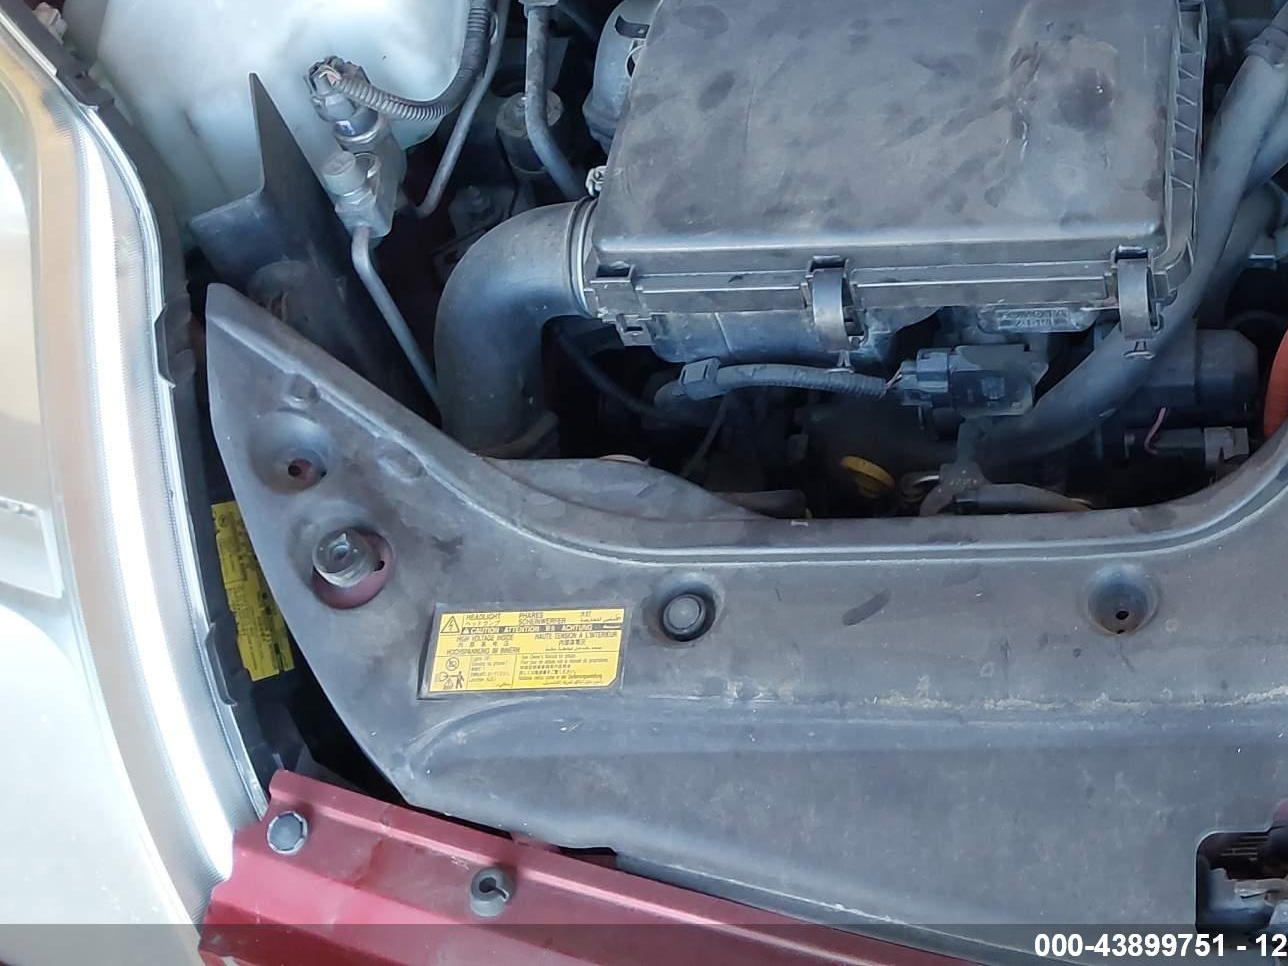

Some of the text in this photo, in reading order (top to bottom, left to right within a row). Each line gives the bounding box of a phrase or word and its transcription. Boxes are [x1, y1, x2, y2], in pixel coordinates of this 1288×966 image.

[470, 626, 500, 635] CAUTION
[503, 625, 540, 634] ATTENTION
[561, 624, 593, 632] ACHTUNG
